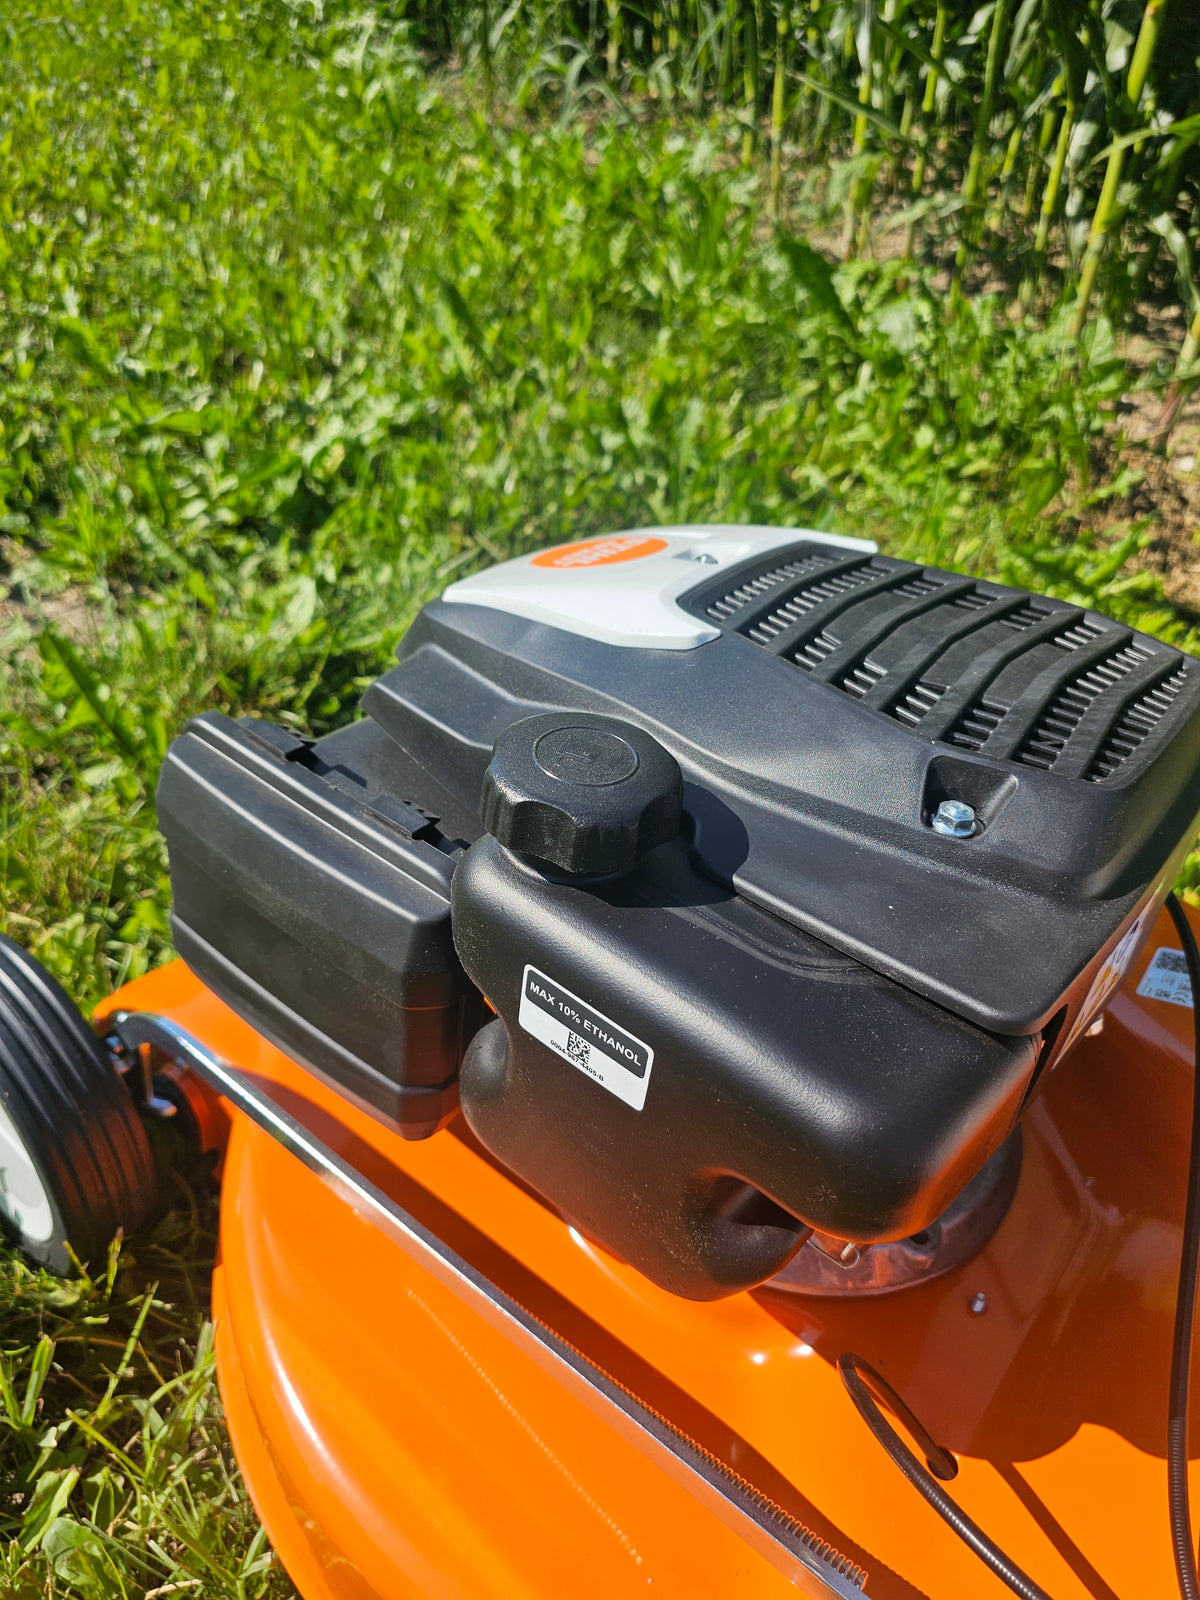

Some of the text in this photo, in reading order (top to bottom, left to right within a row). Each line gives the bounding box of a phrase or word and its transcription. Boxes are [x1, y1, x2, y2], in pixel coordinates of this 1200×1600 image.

[530, 981, 641, 1066] MAX 10% ETHANOL
